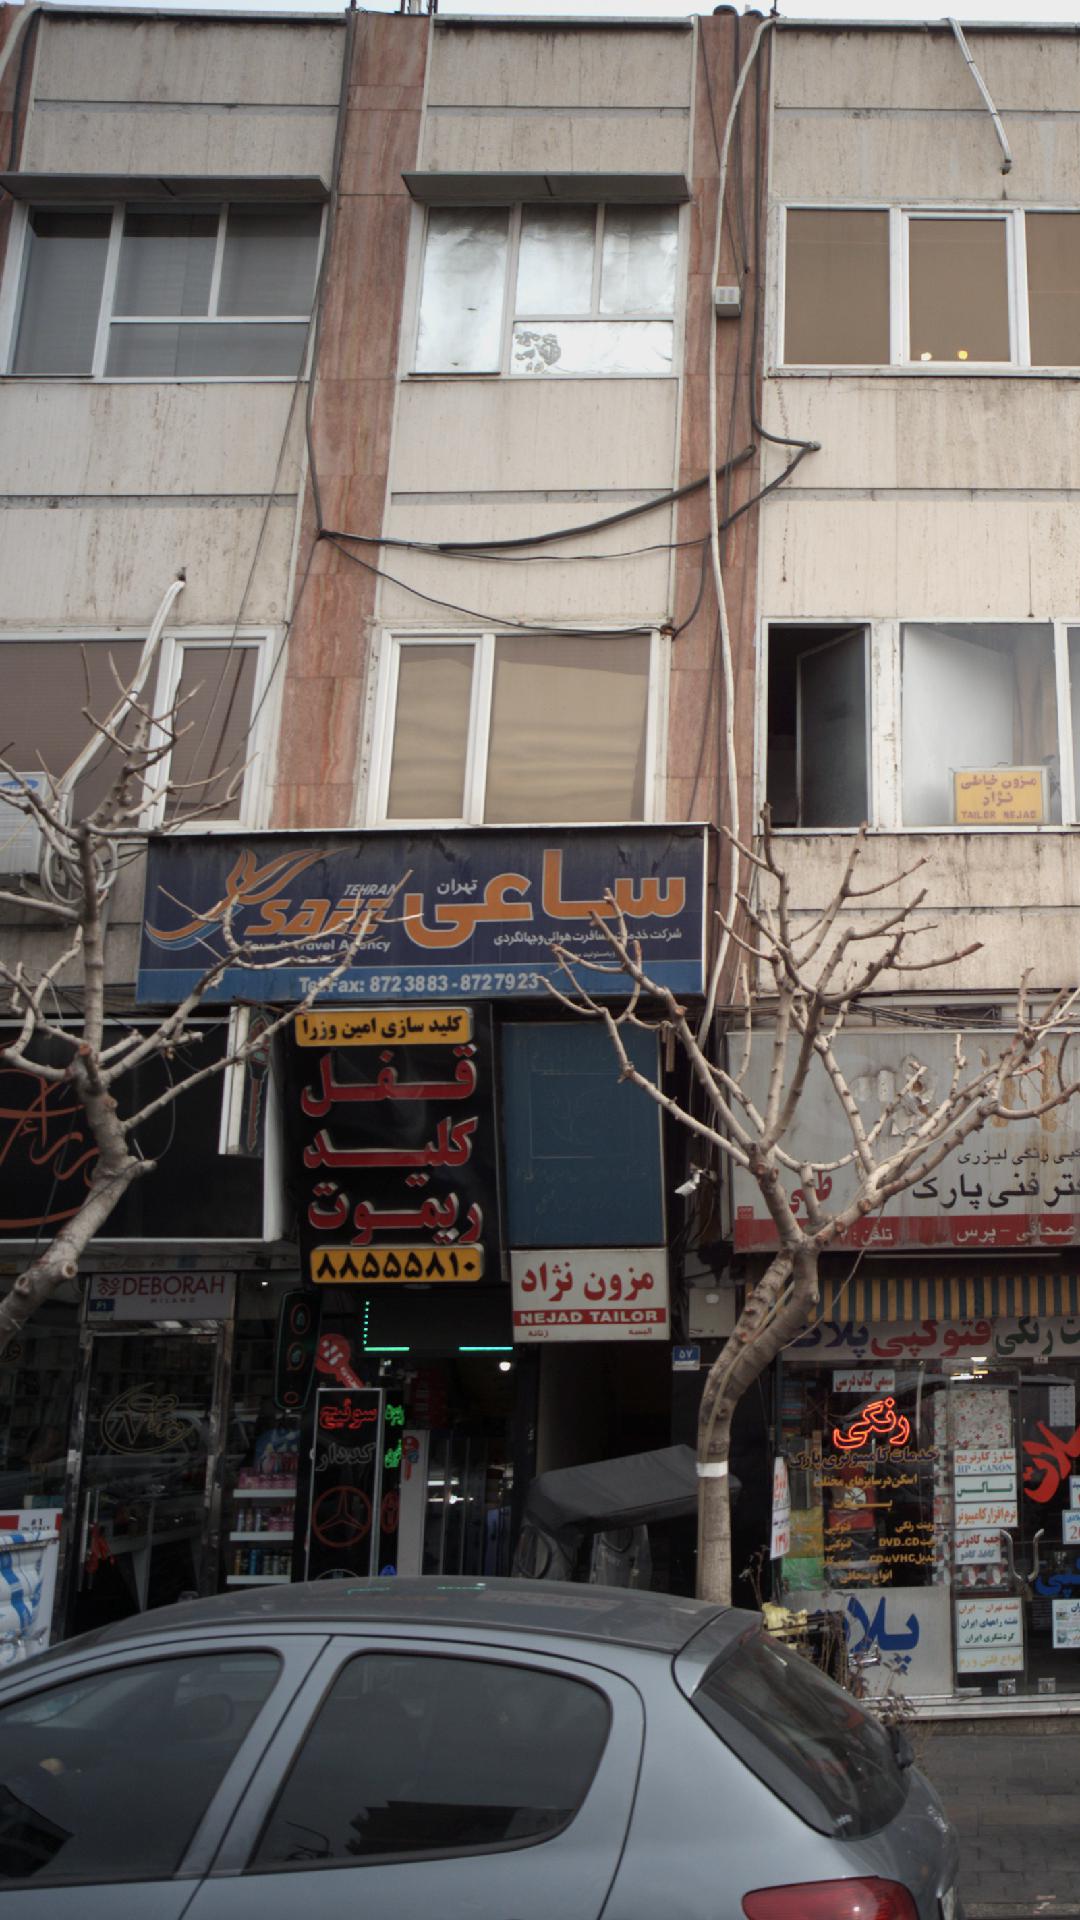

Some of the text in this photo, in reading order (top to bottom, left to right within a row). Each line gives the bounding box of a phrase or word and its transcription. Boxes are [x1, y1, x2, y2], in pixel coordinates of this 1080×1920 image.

[344, 884, 397, 896] TEHRAN
[403, 849, 686, 949] ساعی
[437, 878, 478, 895] تهران
[649, 928, 682, 943] شرکت
[302, 1018, 338, 1041] وزرا
[342, 1017, 377, 1039] امین
[381, 1016, 424, 1038] سازی
[300, 1044, 478, 1118] قفل
[303, 1116, 479, 1187] کلید
[958, 1148, 1007, 1165] لیزری
[912, 1173, 983, 1210] پارک
[988, 1171, 1041, 1209] فنی
[308, 1182, 483, 1246] ریموت
[956, 1226, 997, 1244] پرس
[315, 1252, 476, 1280] ۸۸۵۵۵۸۱۰
[122, 1275, 226, 1296] DEBORAH
[520, 1261, 654, 1302] مزون نژاد
[520, 1309, 658, 1325] NEJAD TAILOR
[871, 1319, 993, 1357] فتوکپی
[832, 1396, 911, 1451] رنگی
